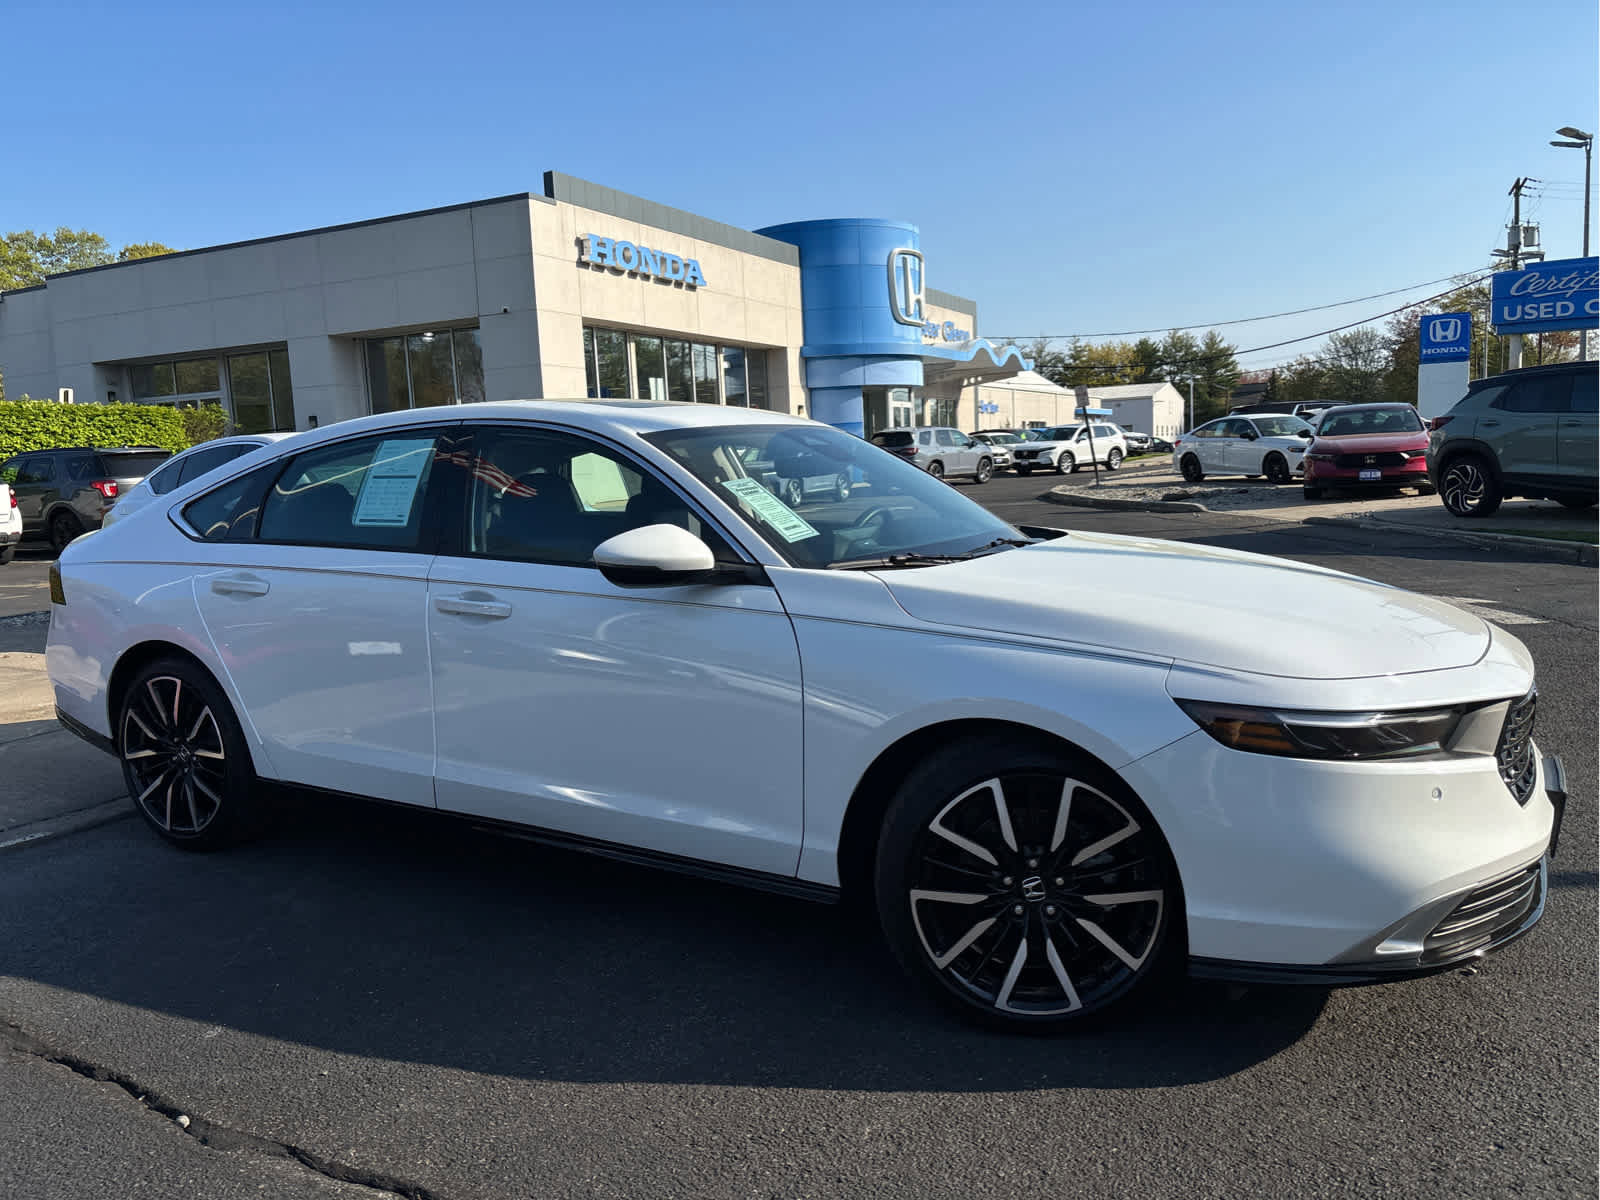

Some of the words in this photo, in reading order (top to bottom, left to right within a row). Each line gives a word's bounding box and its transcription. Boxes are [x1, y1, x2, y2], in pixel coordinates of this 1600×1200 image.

[584, 232, 707, 287] HONDA
[1503, 301, 1575, 321] USED
[1423, 346, 1468, 355] HONDA
